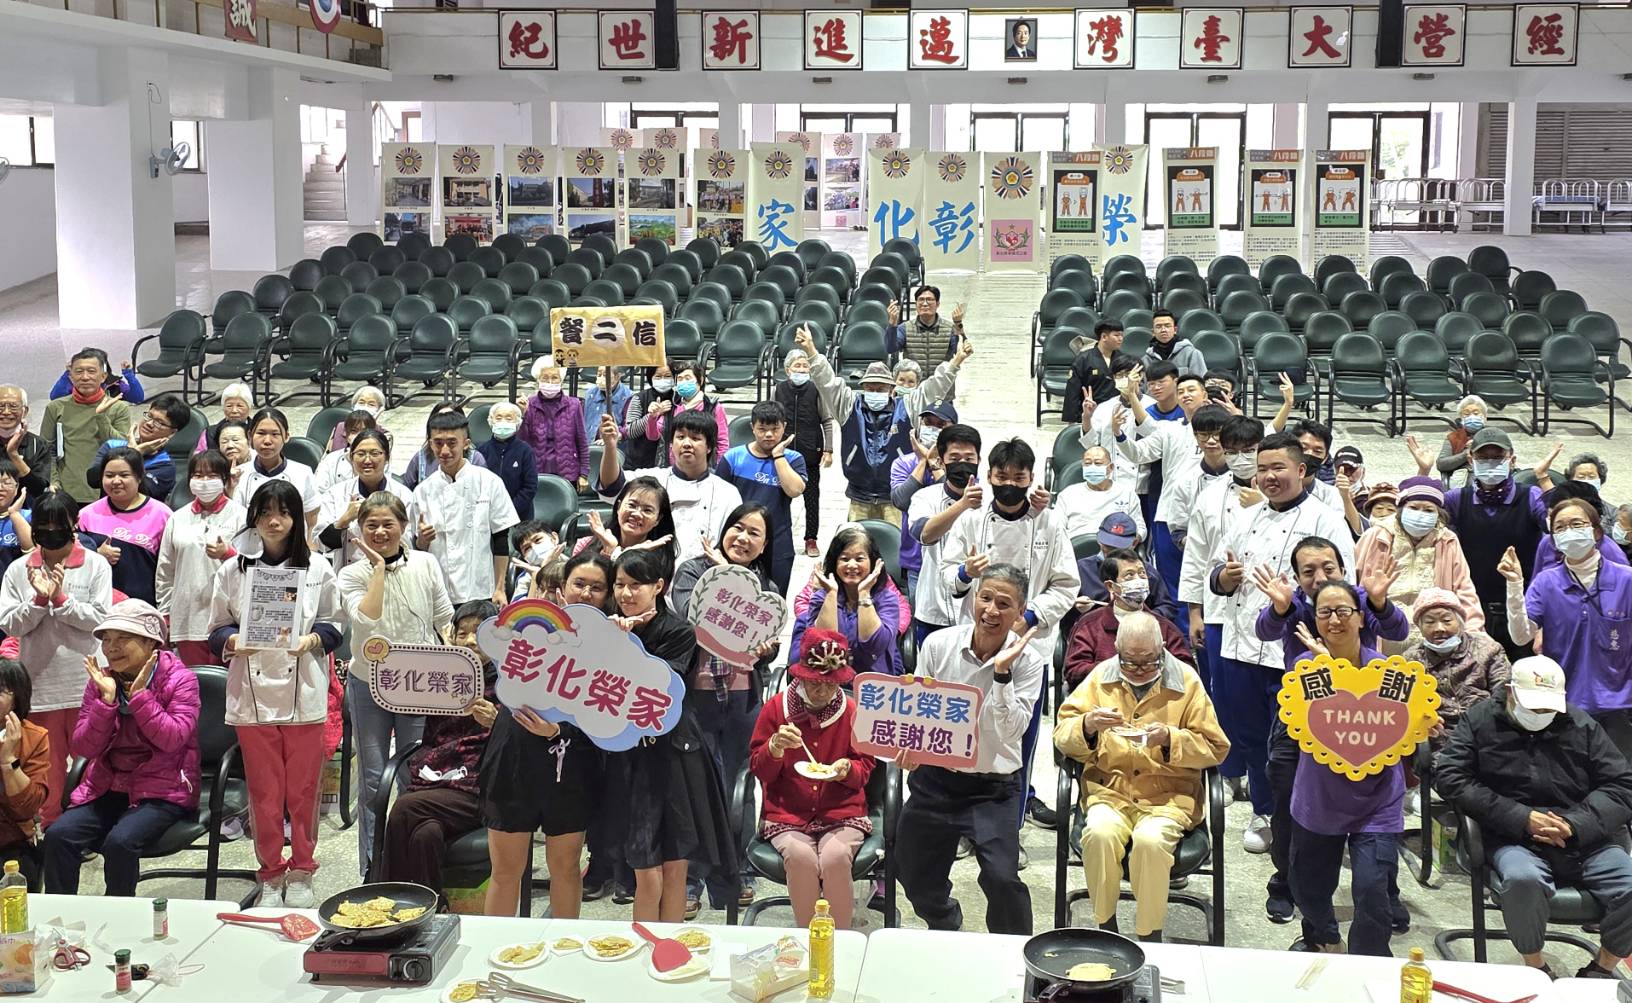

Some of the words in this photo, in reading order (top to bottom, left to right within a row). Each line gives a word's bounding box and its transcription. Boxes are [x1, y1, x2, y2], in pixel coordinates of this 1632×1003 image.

[508, 21, 549, 59] 紀
[608, 19, 646, 60] 世
[709, 17, 753, 65] 新
[813, 18, 854, 64] 進
[920, 17, 960, 65] 邁
[1087, 15, 1124, 63] 灣
[1194, 15, 1230, 62] 臺
[1303, 15, 1342, 59] 大
[1413, 13, 1455, 58] 營
[1526, 13, 1565, 57] 經
[758, 198, 798, 252] 家
[873, 199, 920, 247] 化
[928, 201, 975, 254] 彰
[1102, 193, 1137, 246] 榮
[715, 588, 774, 627] 彰化榮家
[378, 668, 474, 696] 彰化榮家
[500, 638, 673, 731] 彰化榮家
[859, 683, 971, 725] 彰化榮家
[1322, 708, 1396, 726] THANK
[1334, 730, 1377, 746] YOU
